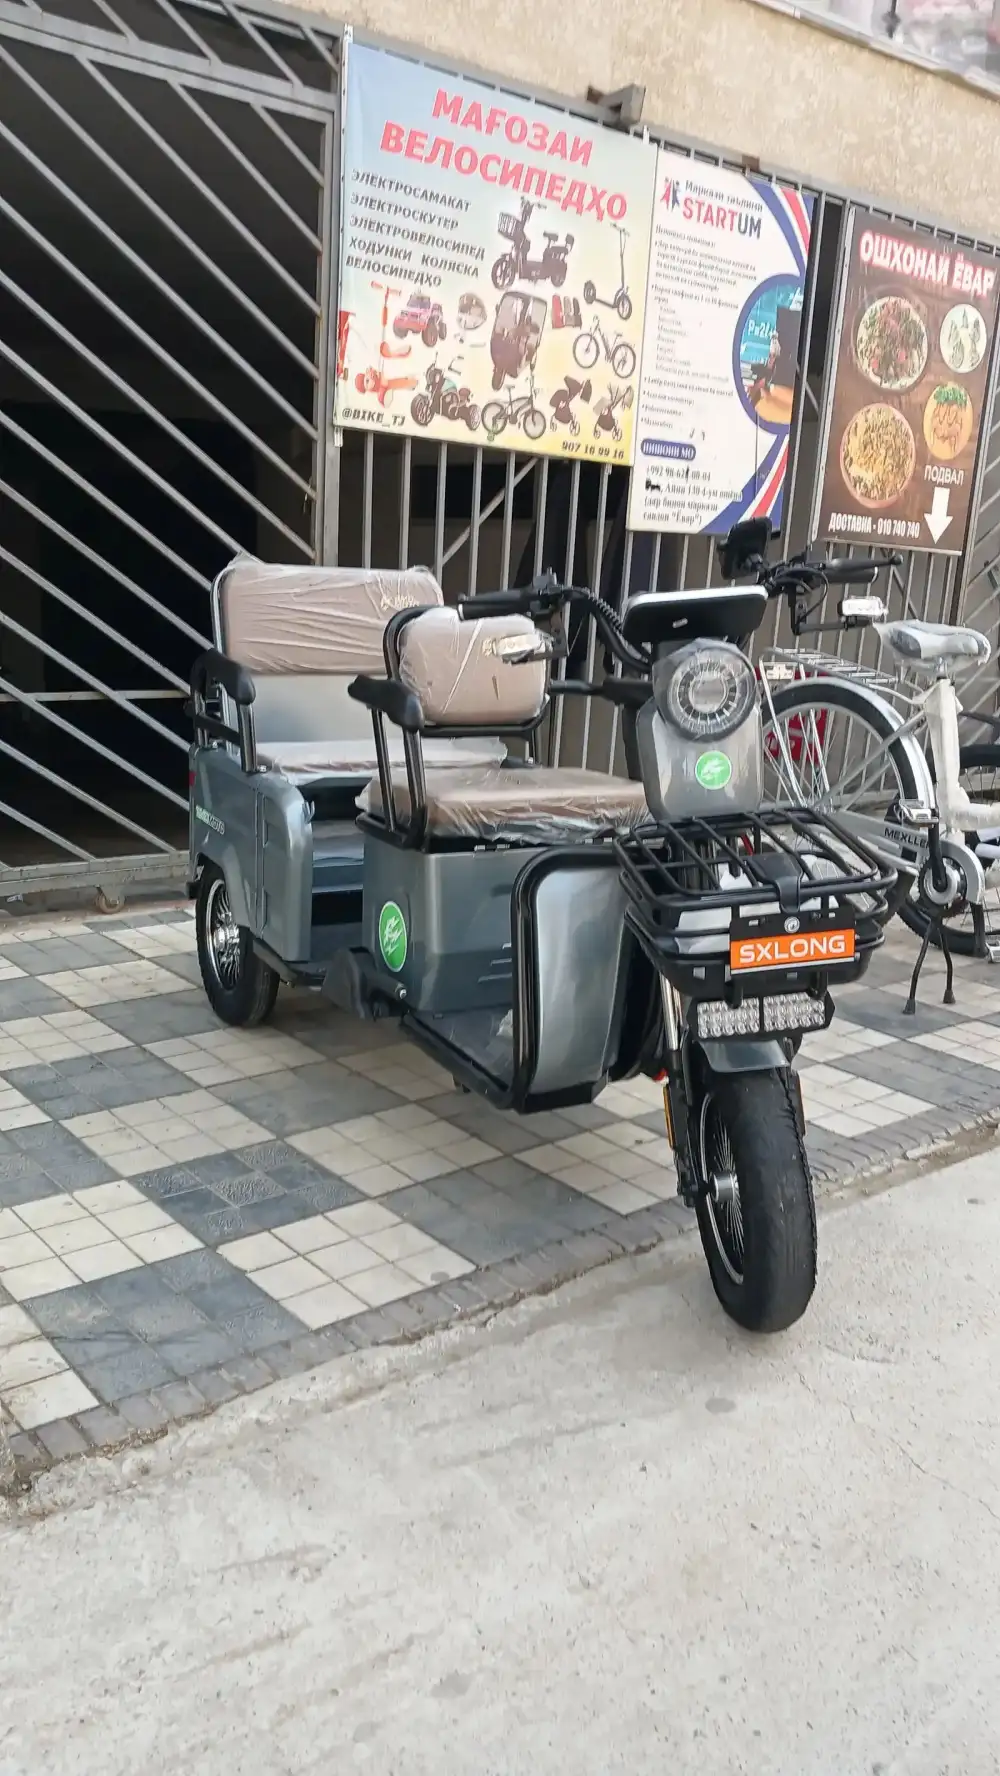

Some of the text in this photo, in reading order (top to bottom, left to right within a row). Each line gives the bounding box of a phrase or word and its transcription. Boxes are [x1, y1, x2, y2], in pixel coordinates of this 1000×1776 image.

[432, 88, 594, 168] МАҒОЗАИ
[380, 119, 628, 222] ВЕЛОСИПЕДҲО
[351, 169, 471, 212] ЭЛЕКТРОСАМАКАТ
[350, 192, 459, 231] ЭЛЕКТРОСКУТЕР
[682, 196, 762, 240] STARTUM
[349, 214, 485, 261] ЭЛЕКТРОВЕЛОСИПЕД
[349, 236, 479, 278] ХОДУНКИ КОЛЯСКА
[346, 255, 442, 287] ВЕЛОСИПЕДҲО
[860, 231, 996, 296] ОШХОНАИ ЁВАР
[342, 408, 406, 428] @BIKE_TJ
[562, 440, 581, 453] 907
[924, 464, 965, 486] ПОДВАЛ
[828, 512, 872, 533] ДОСТАВКА
[878, 518, 892, 535] 010
[892, 520, 906, 537] 740
[907, 522, 920, 538] 740
[884, 827, 930, 849] MEXLLE
[739, 934, 846, 964] SXLONG
